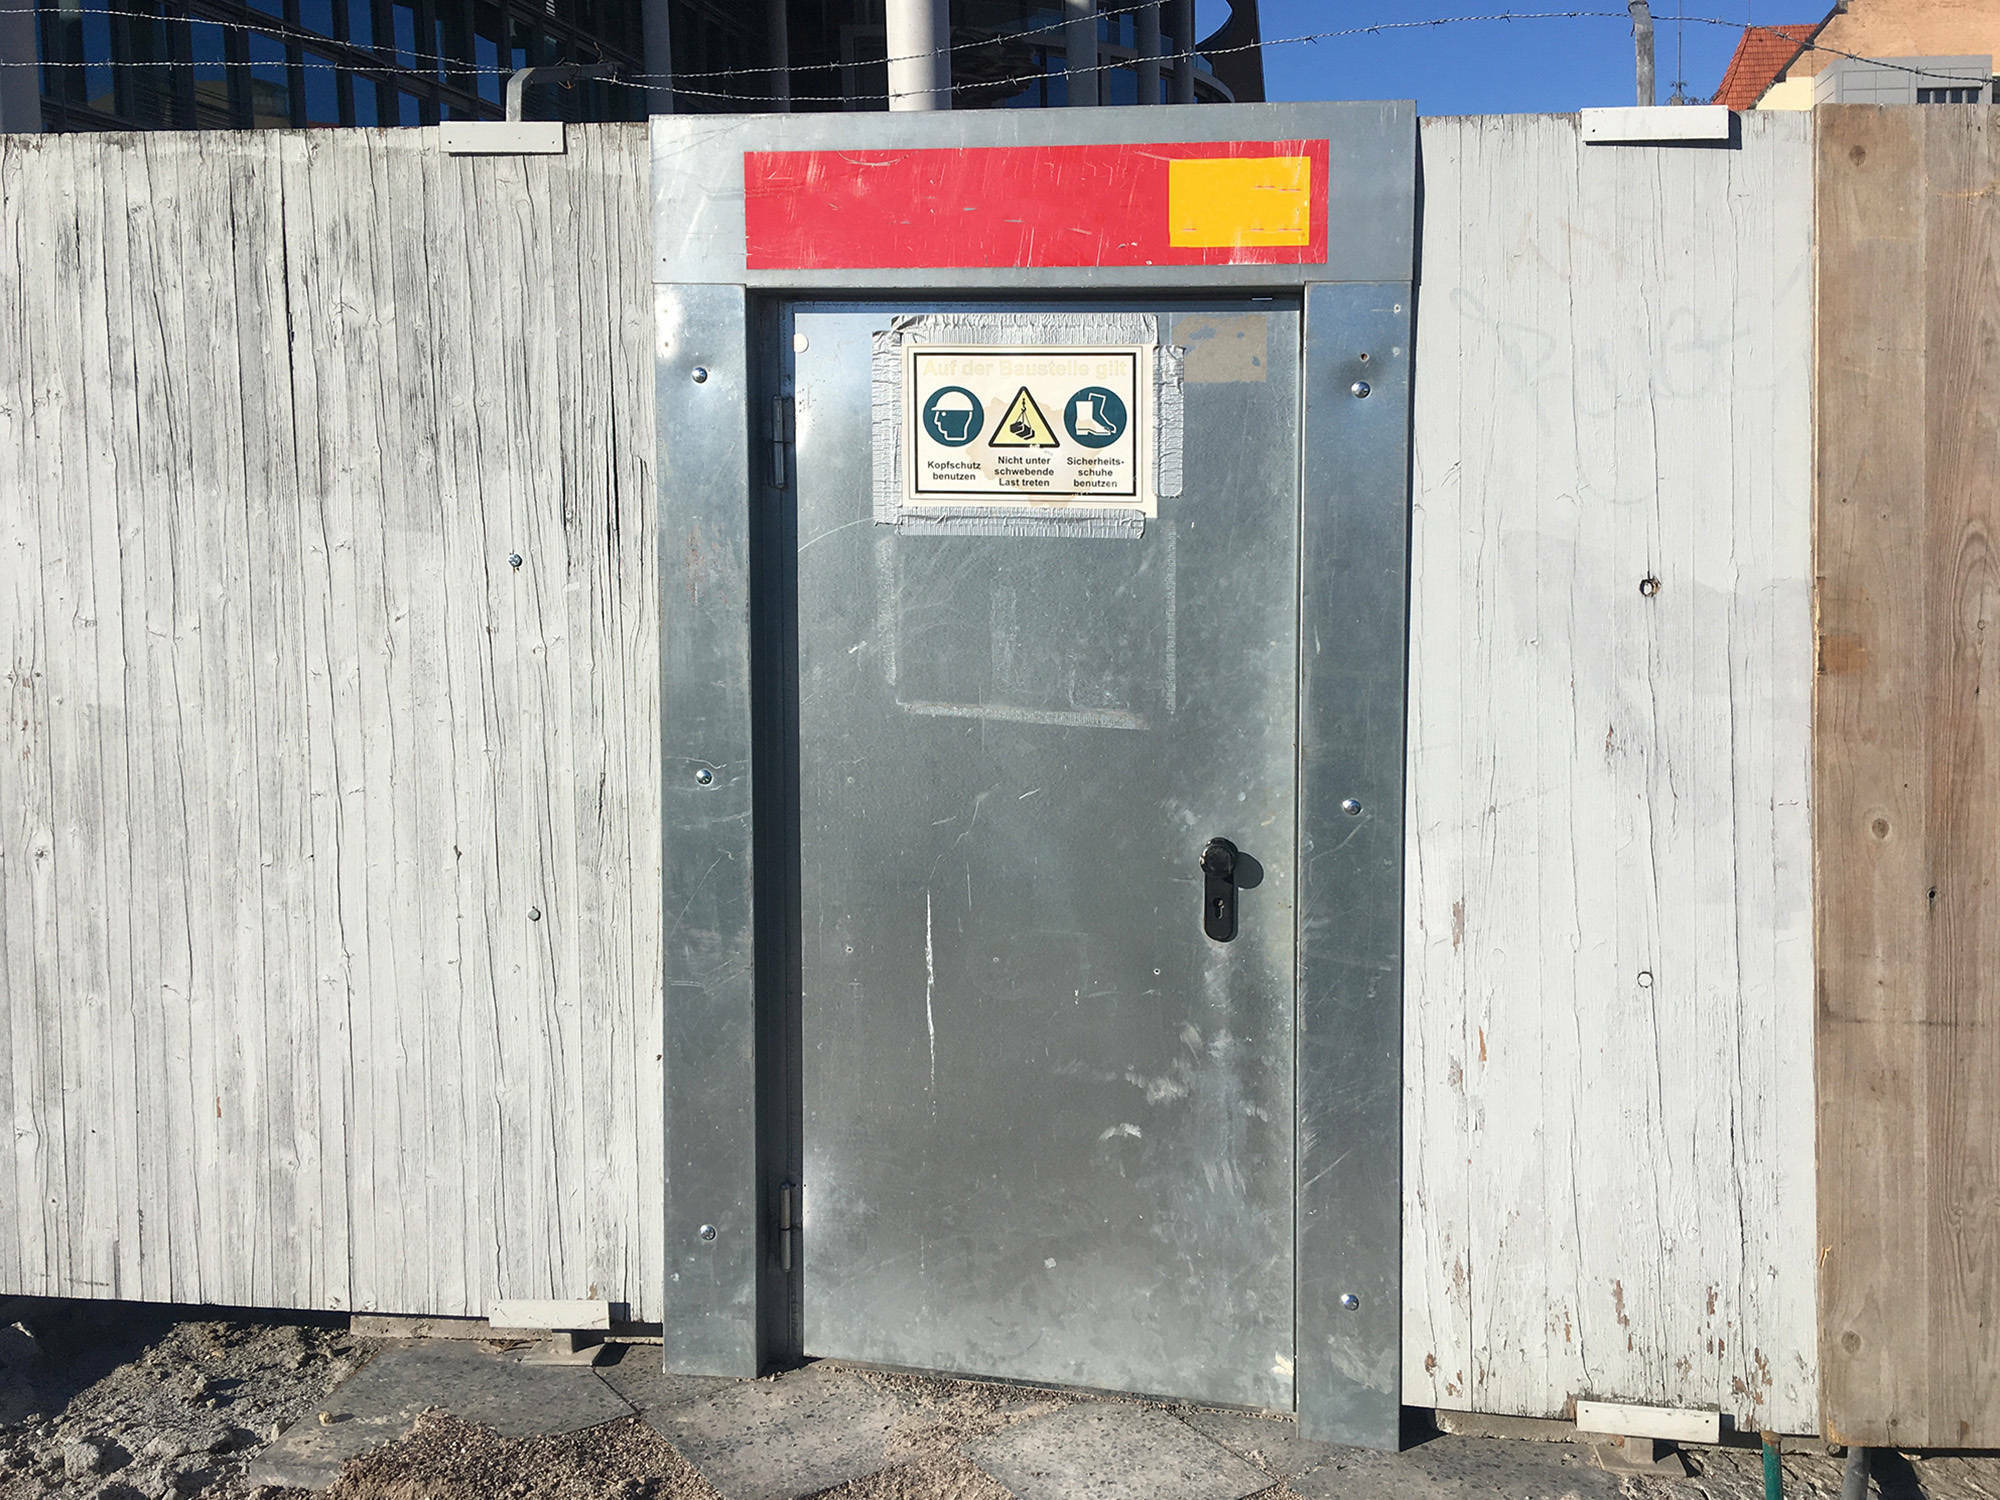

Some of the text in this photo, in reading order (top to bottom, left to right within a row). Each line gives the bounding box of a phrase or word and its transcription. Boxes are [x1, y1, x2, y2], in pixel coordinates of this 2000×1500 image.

[923, 359, 957, 376] Auf
[961, 359, 994, 376] der
[1000, 359, 1089, 376] Baustelle
[998, 456, 1051, 465] Nicht unter
[1067, 457, 1125, 465] Sicherheits-
[928, 461, 981, 470] Kopfschutz
[933, 472, 976, 480] benutzen
[994, 468, 1054, 476] schwebende
[1078, 468, 1113, 477] schuhe
[1022, 479, 1050, 487] treten
[1073, 479, 1118, 488] benutzen
